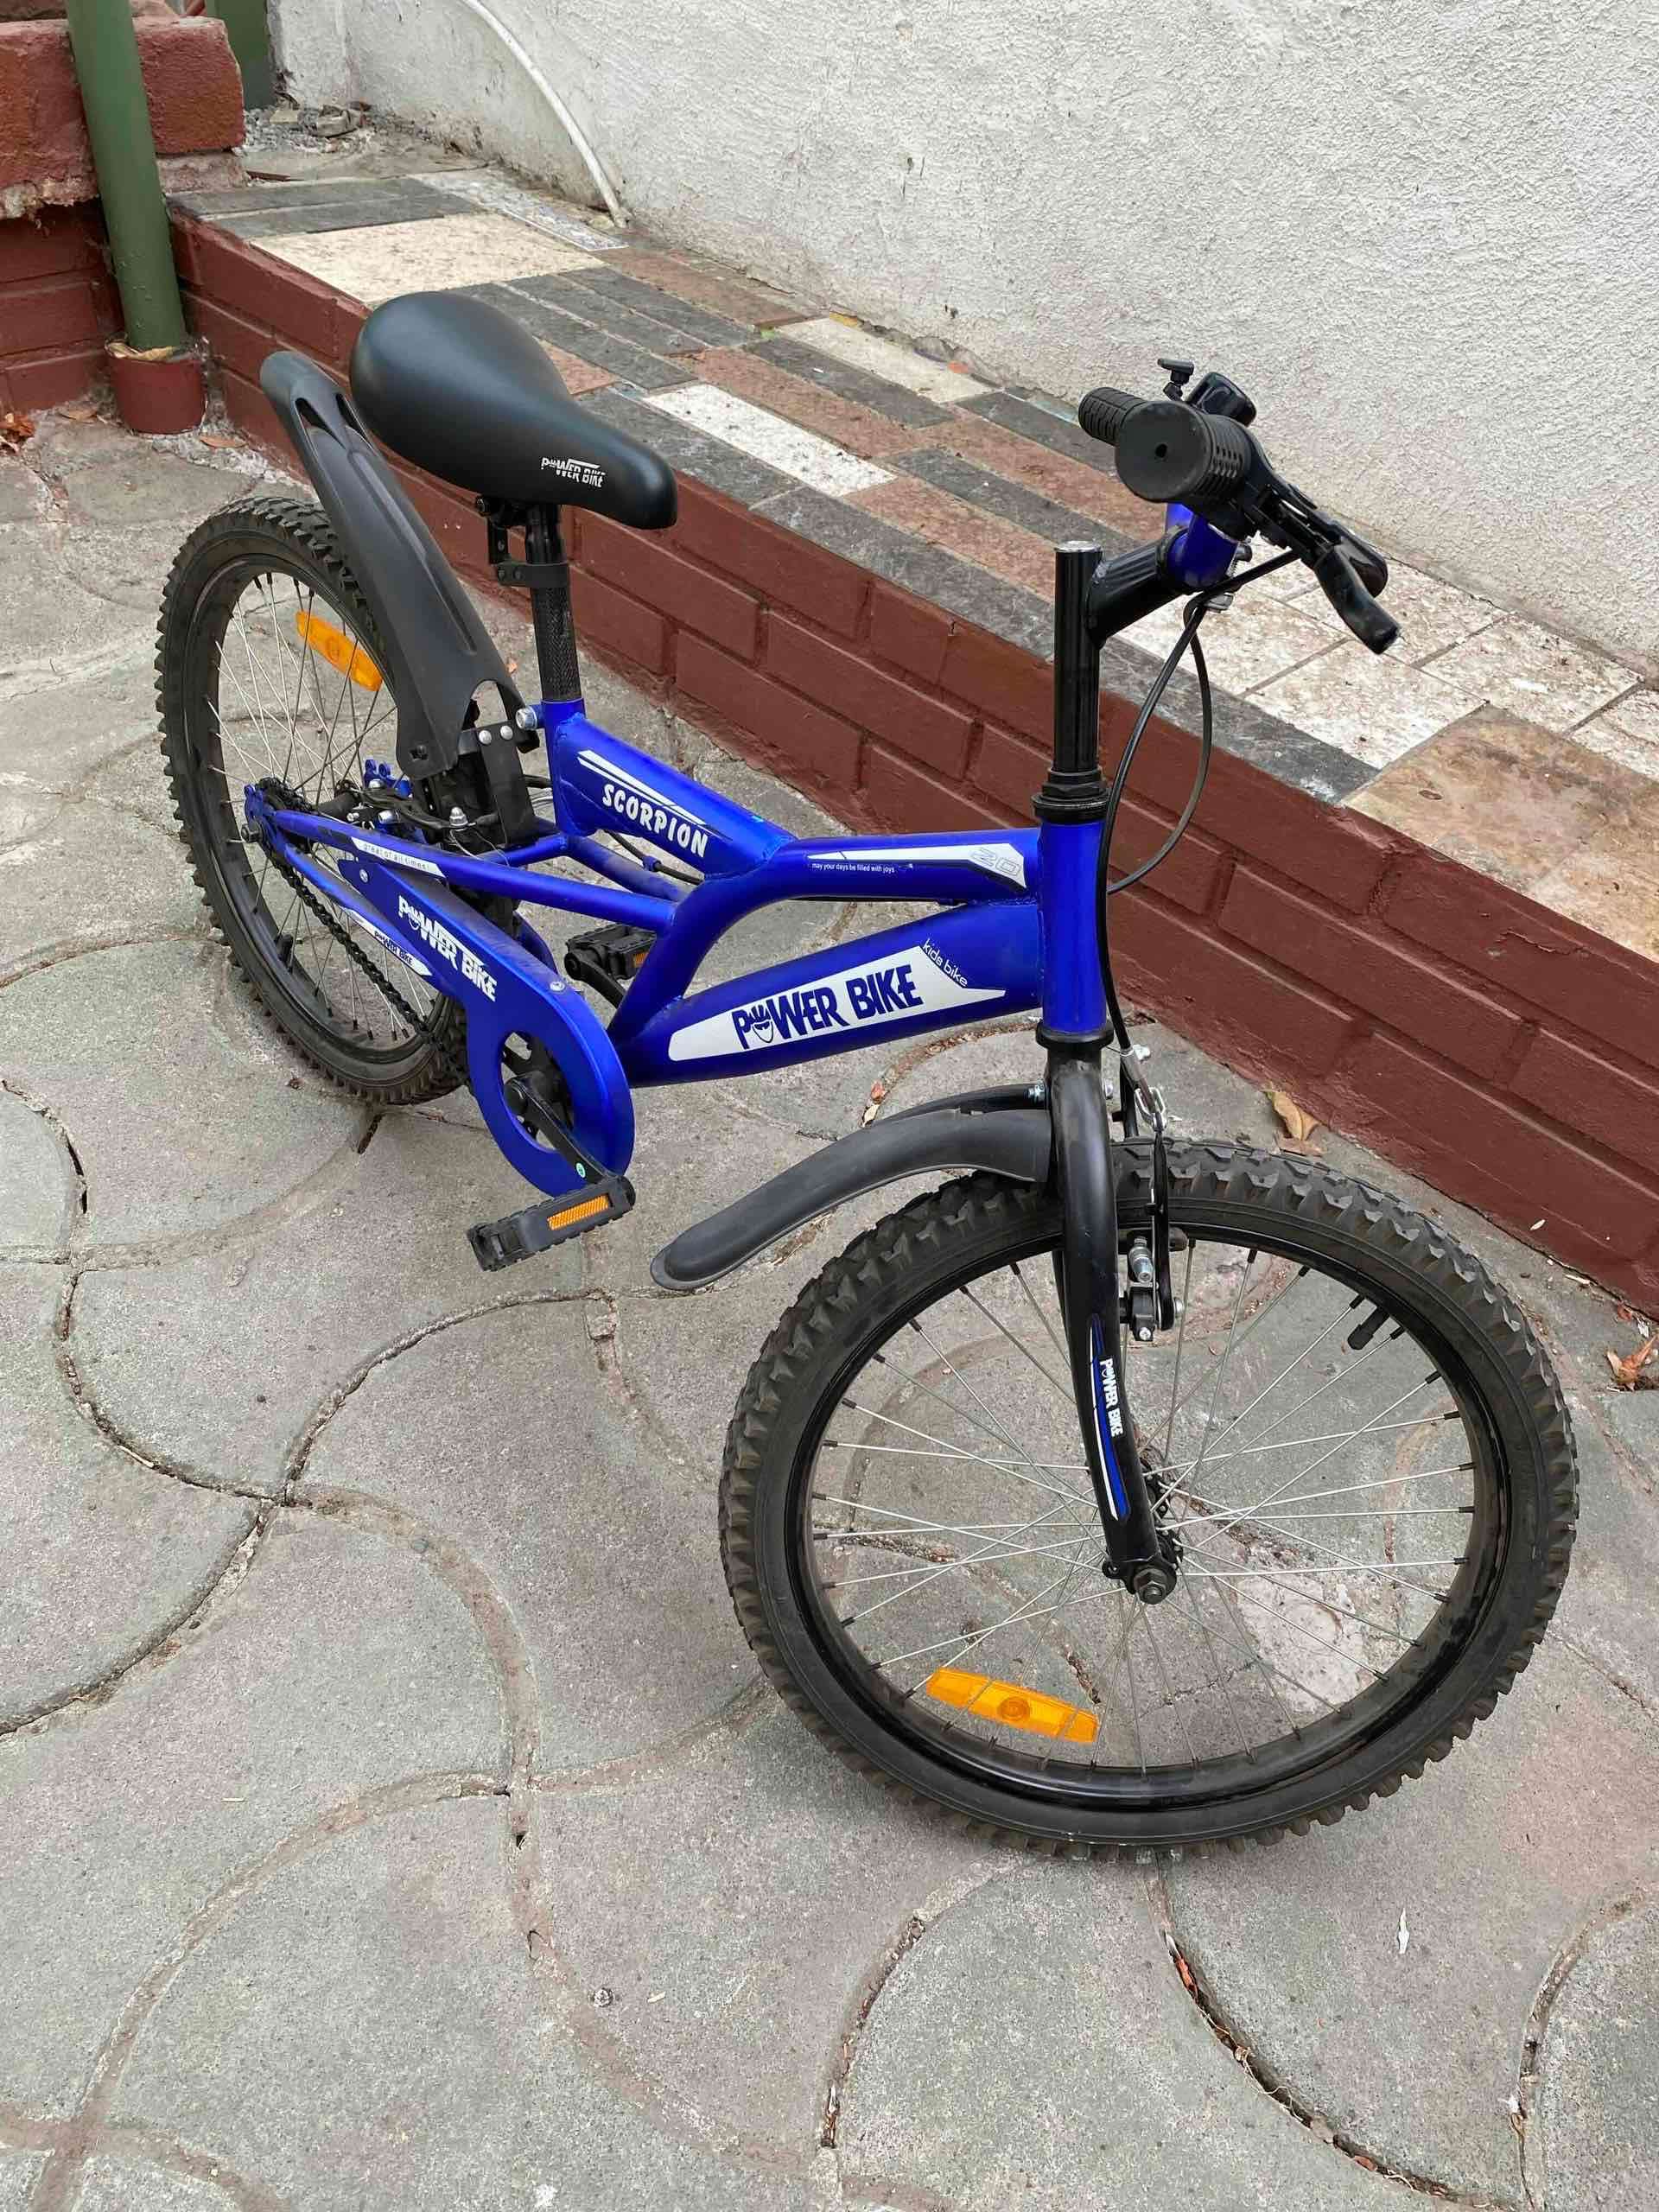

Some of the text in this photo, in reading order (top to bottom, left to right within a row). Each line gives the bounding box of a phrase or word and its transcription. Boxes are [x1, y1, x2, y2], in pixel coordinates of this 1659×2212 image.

[541, 457, 606, 487] POWER BIKE
[602, 784, 709, 858] SCORPION
[836, 863, 849, 872] days
[398, 895, 498, 1002] POWER BIKE
[923, 938, 968, 987] kids bike
[731, 964, 925, 1050] POWER BIKE
[1099, 1357, 1124, 1438] POWER BIKE
